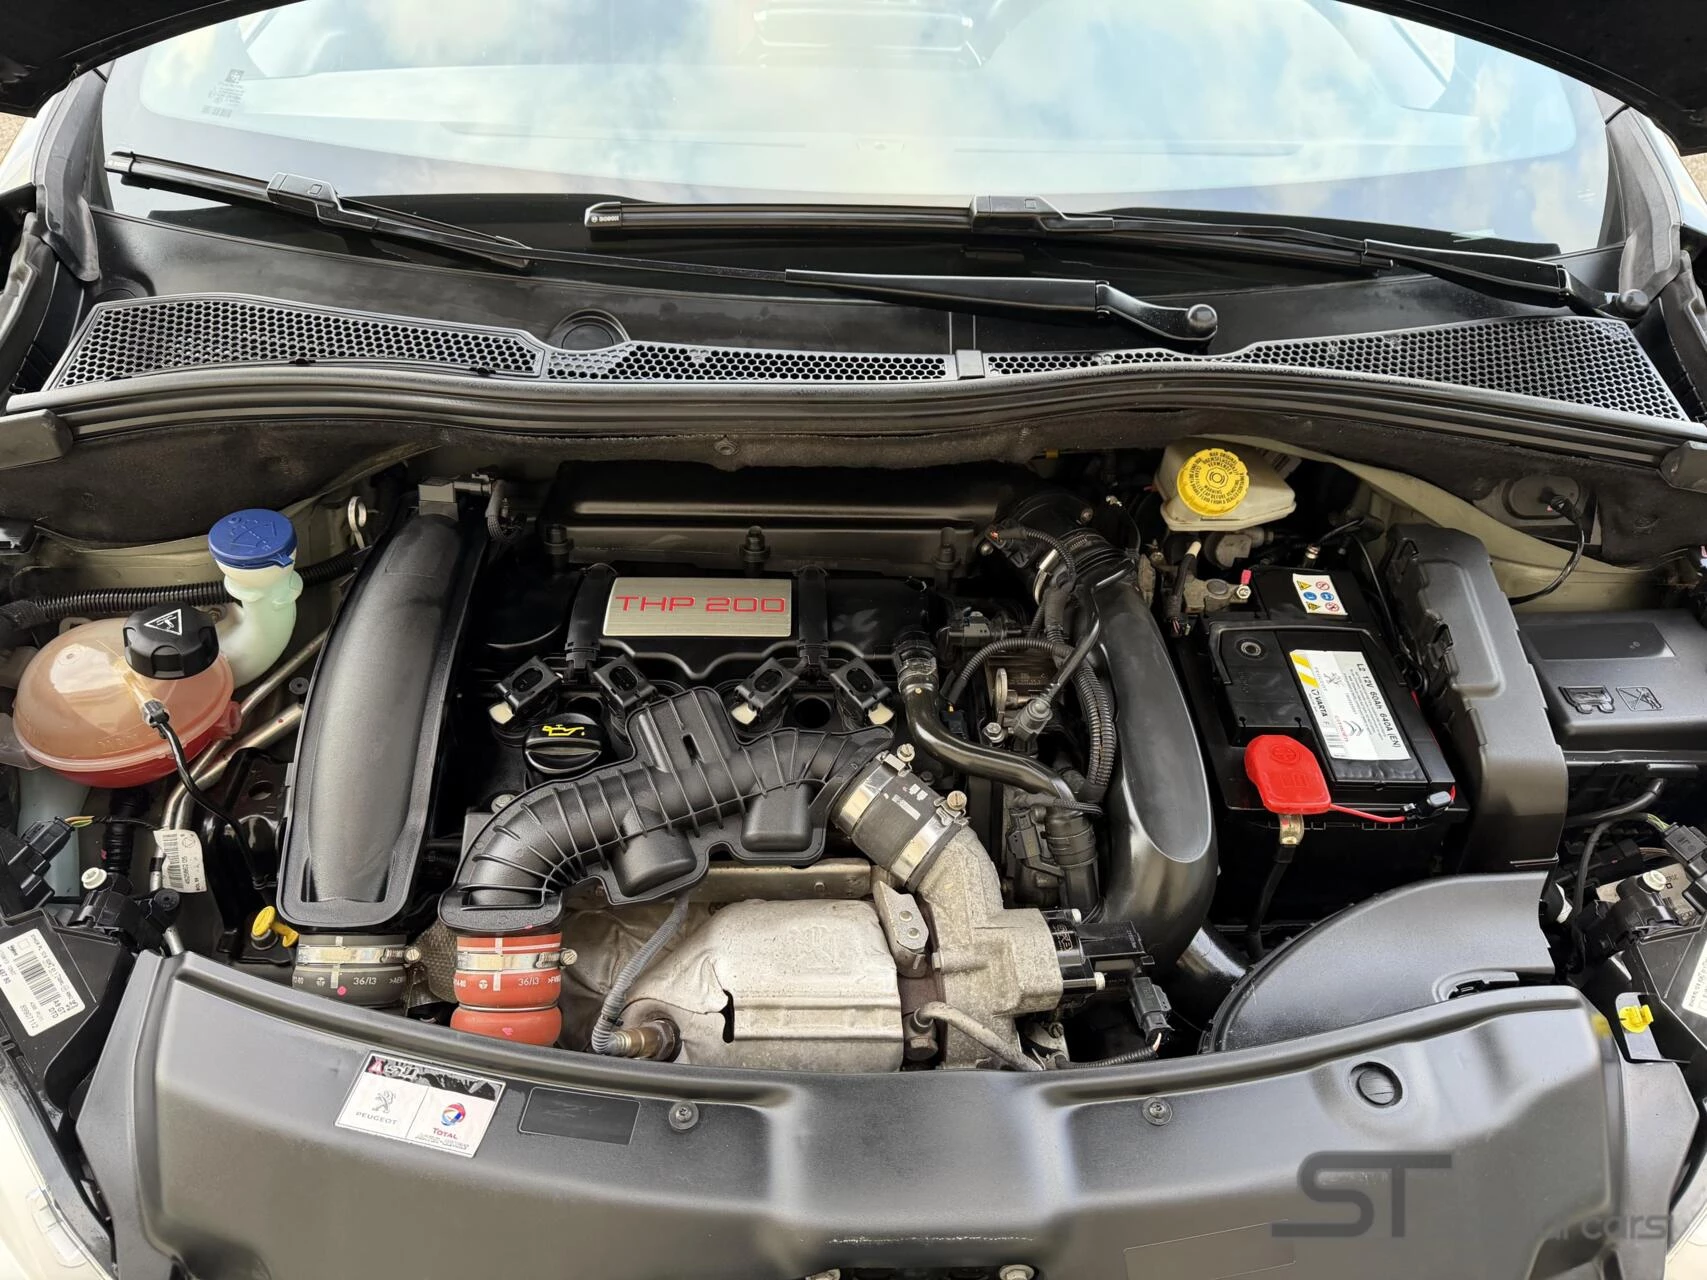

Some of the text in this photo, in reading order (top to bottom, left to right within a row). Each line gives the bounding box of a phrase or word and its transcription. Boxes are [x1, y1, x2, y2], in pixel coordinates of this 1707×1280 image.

[615, 596, 786, 613] THP 200
[1314, 696, 1328, 716] VARTA
[1356, 663, 1366, 671] L2
[1361, 676, 1374, 688] 12V
[1368, 691, 1383, 709] 60Ah
[1378, 713, 1393, 731] 640A
[1386, 733, 1401, 747] (EN)
[353, 976, 377, 986] 36/13
[518, 976, 540, 986] 36/13
[356, 1112, 398, 1125] PEUGEOT
[432, 1127, 458, 1140] TOTAL
